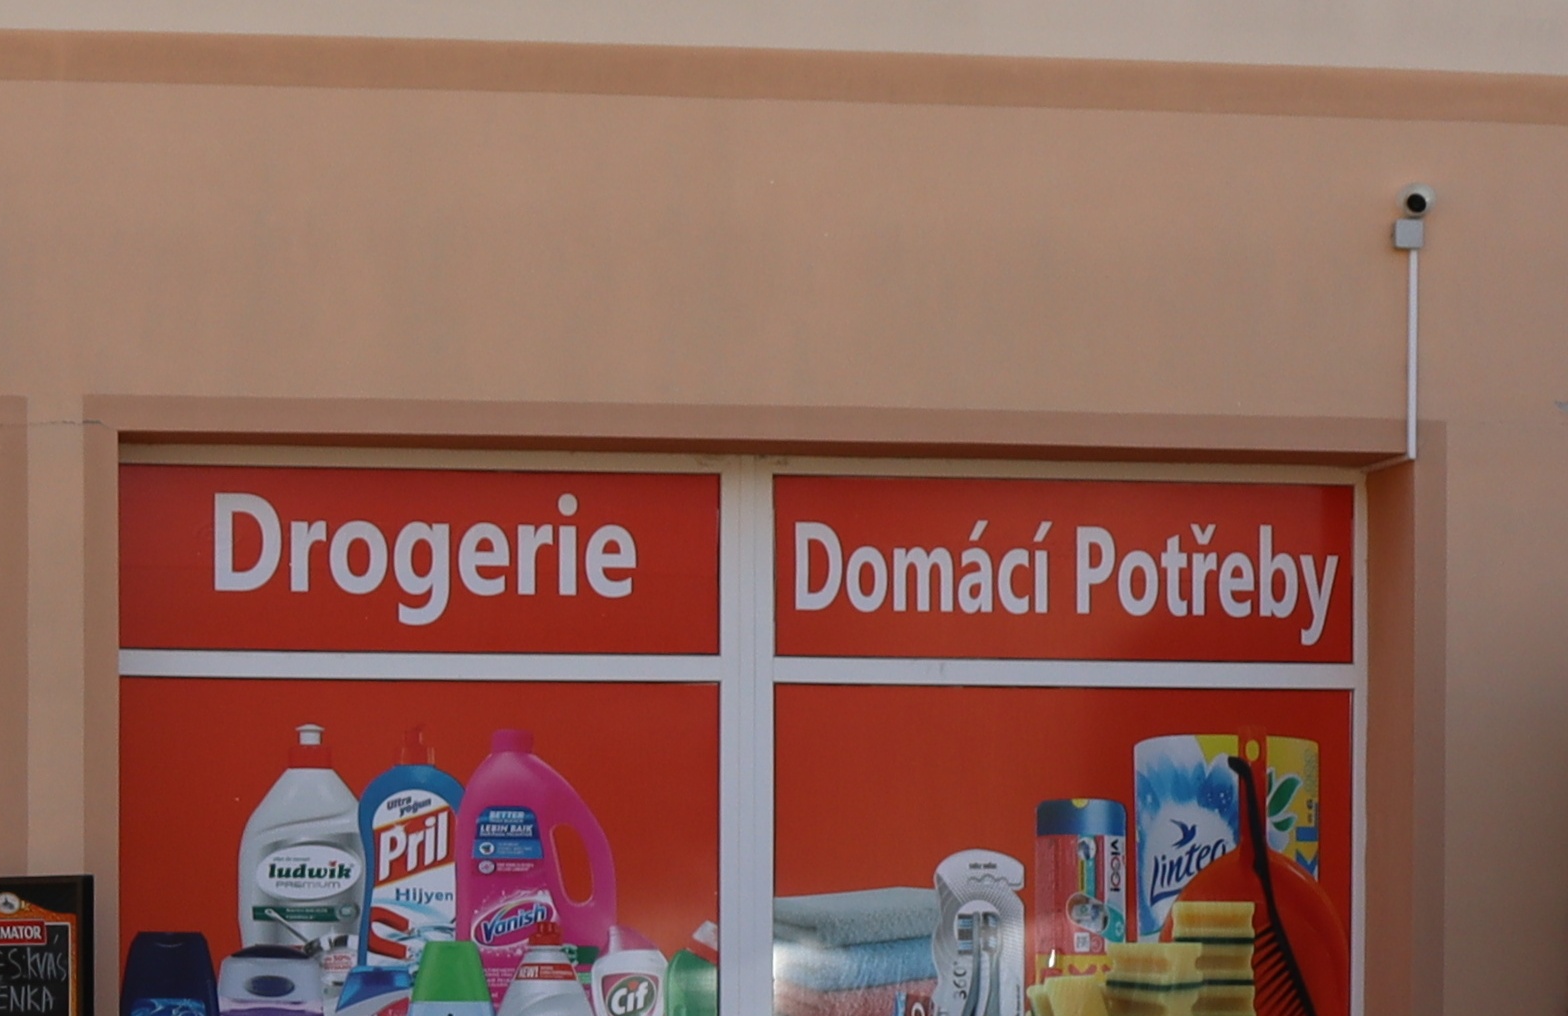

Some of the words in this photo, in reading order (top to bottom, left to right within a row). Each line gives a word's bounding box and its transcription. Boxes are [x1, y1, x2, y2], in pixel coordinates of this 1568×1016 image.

[212, 492, 637, 625] Drogerie
[793, 519, 1053, 614] Domácí
[1075, 523, 1339, 647] Potřeby
[378, 810, 449, 882] Pril
[268, 861, 352, 879] ludwik
[275, 881, 341, 889] PREMIUM
[395, 887, 454, 905] Hijyen
[482, 902, 548, 944] Vanish
[609, 978, 651, 1015] Cif
